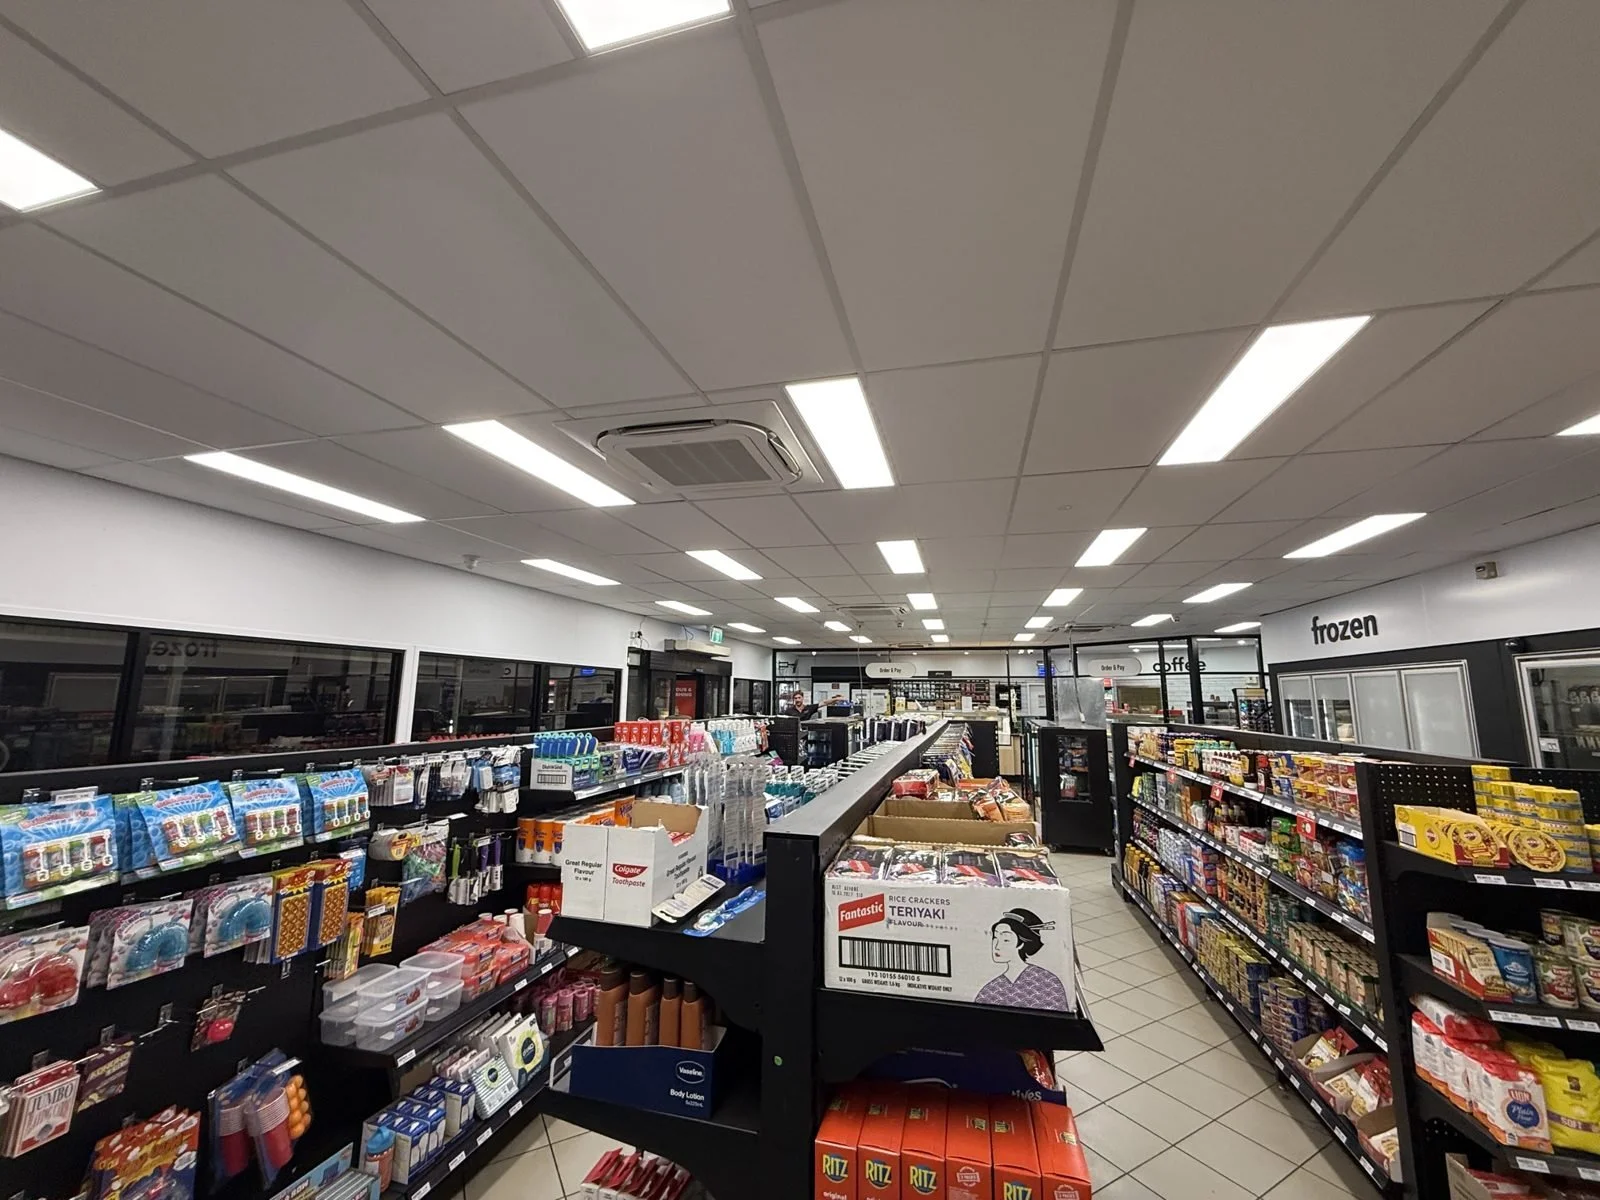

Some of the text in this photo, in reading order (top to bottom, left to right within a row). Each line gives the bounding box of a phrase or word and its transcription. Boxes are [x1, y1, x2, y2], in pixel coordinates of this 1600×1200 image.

[1311, 614, 1379, 645] frozen
[581, 860, 602, 869] Regular
[614, 864, 642, 875] Colgate
[574, 868, 594, 876] Flavour
[612, 877, 646, 888] Toothpaste
[889, 895, 951, 906] RICE CRACKERS
[840, 902, 884, 922] Fantastic
[889, 906, 945, 920] TERIYAKI
[679, 1066, 702, 1076] Vaseline
[30, 1083, 74, 1113] JUMBO
[670, 1088, 705, 1101] Body Lotion
[1512, 1104, 1534, 1116] Plain
[822, 1154, 848, 1178] RITZ
[865, 1160, 892, 1184] RITZ
[910, 1166, 937, 1189] RITZ
[1003, 1182, 1032, 1200] RITZ
